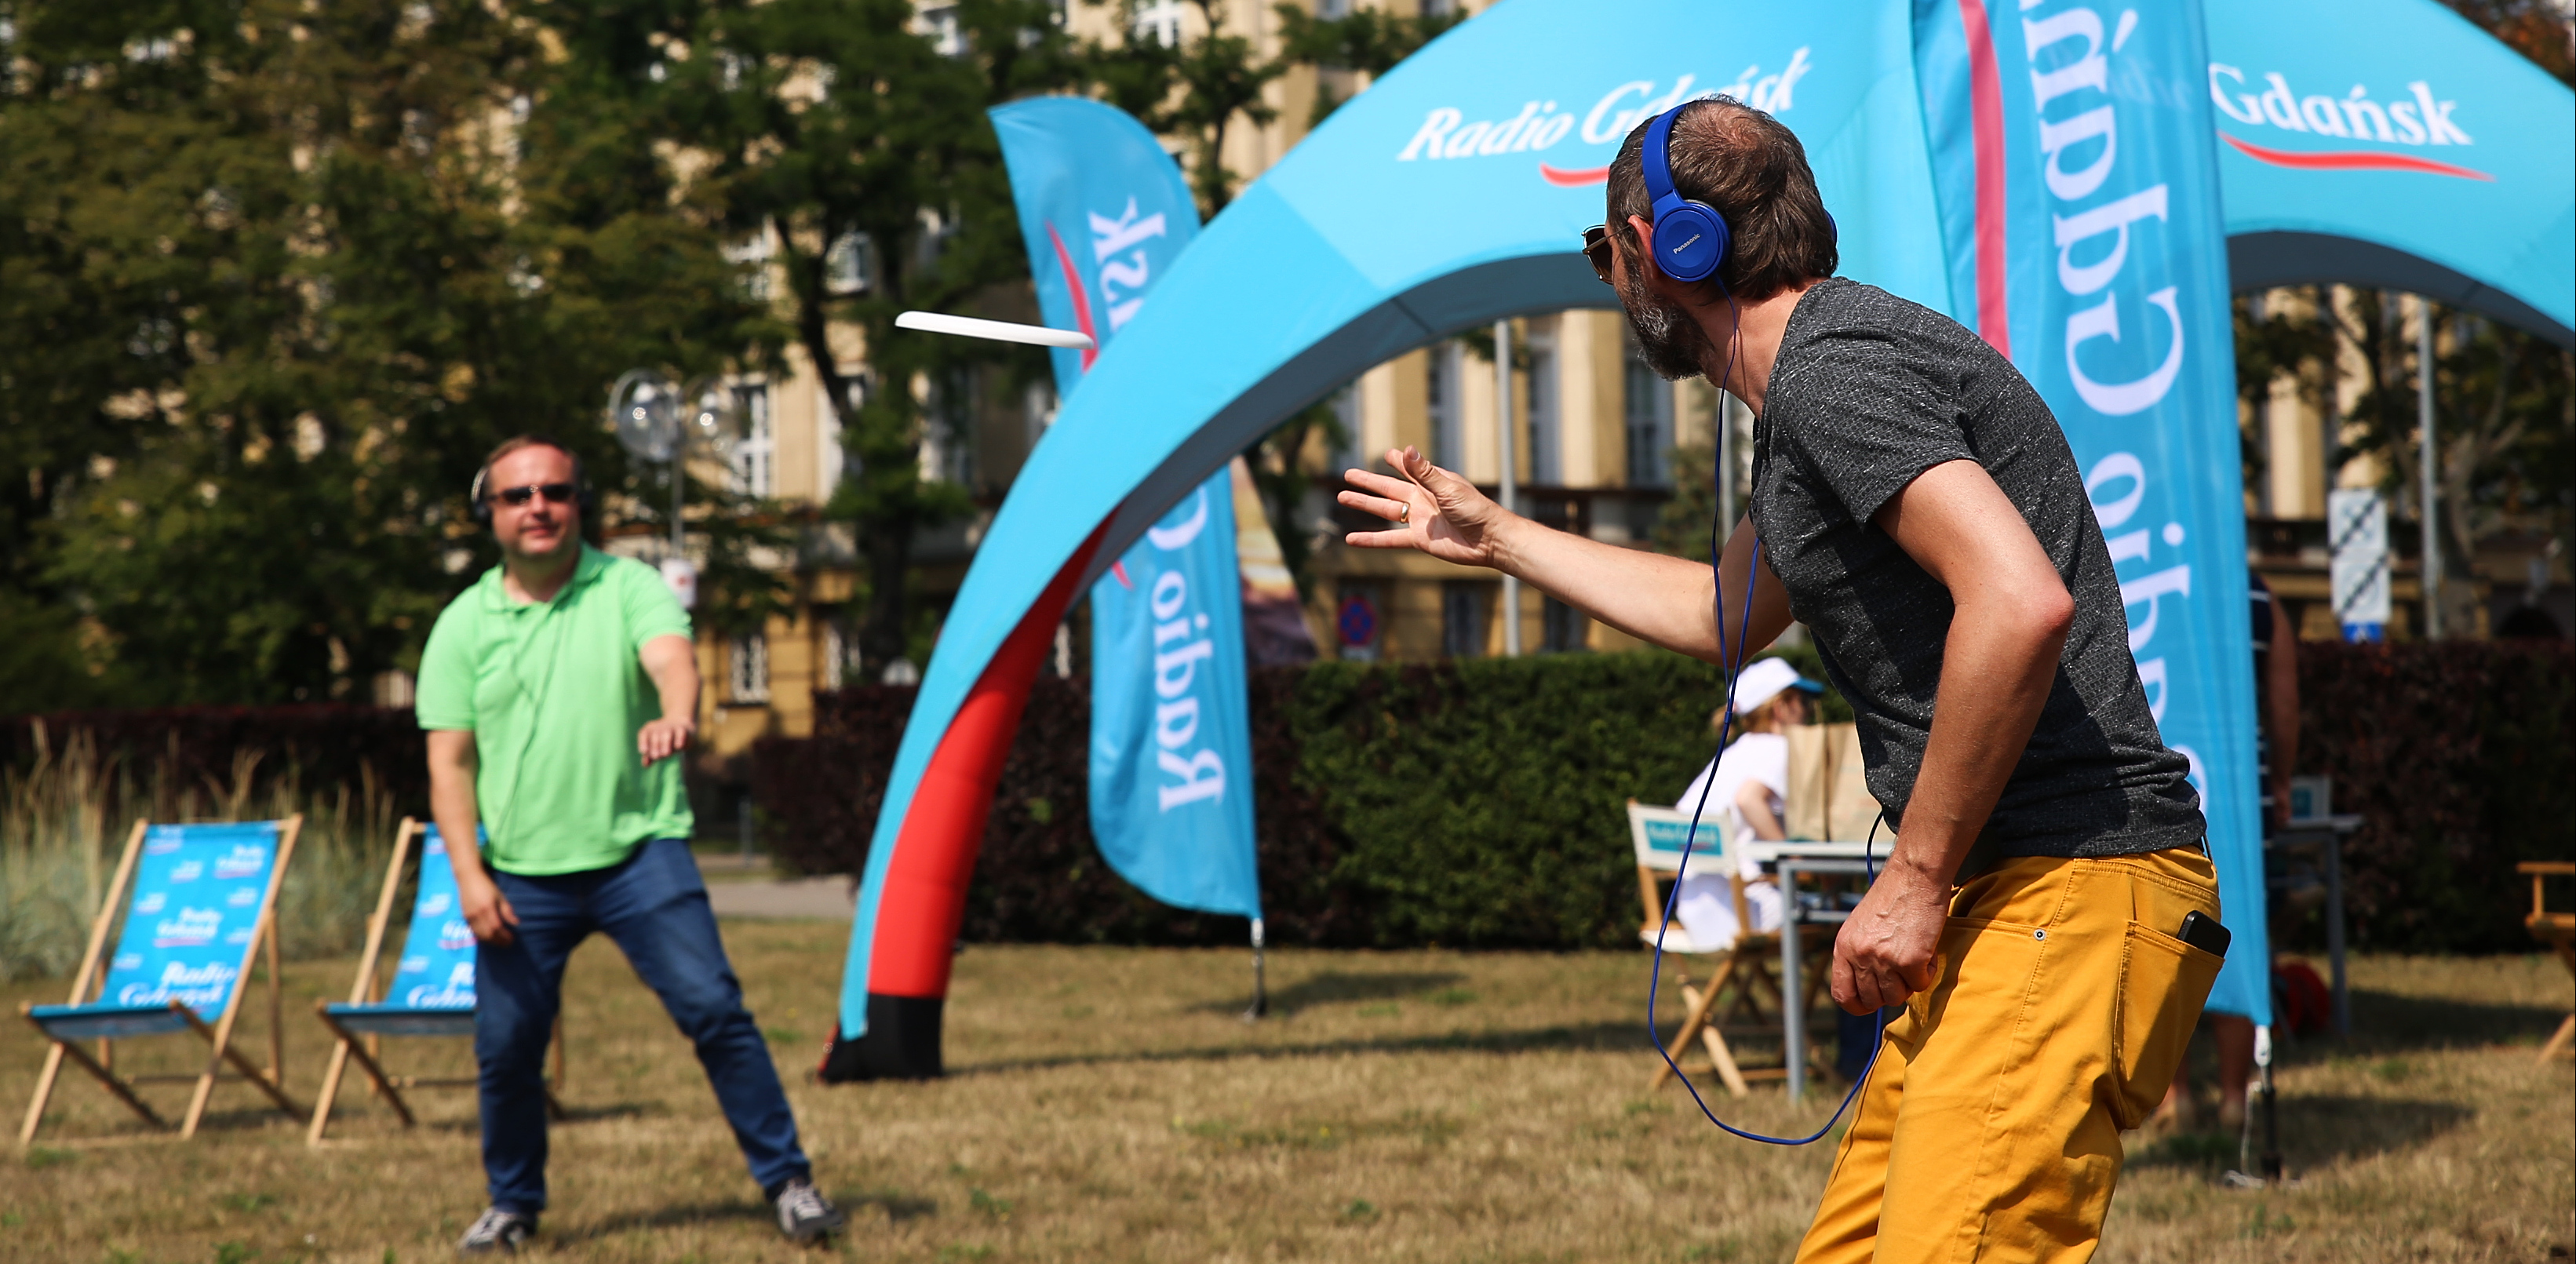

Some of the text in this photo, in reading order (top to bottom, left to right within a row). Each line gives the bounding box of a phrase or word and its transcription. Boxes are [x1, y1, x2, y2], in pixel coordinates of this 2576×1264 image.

[1397, 46, 1812, 162] Radio Gdńsk
[2209, 62, 2472, 146] Gdańsk
[1672, 232, 1701, 255] Panasonic
